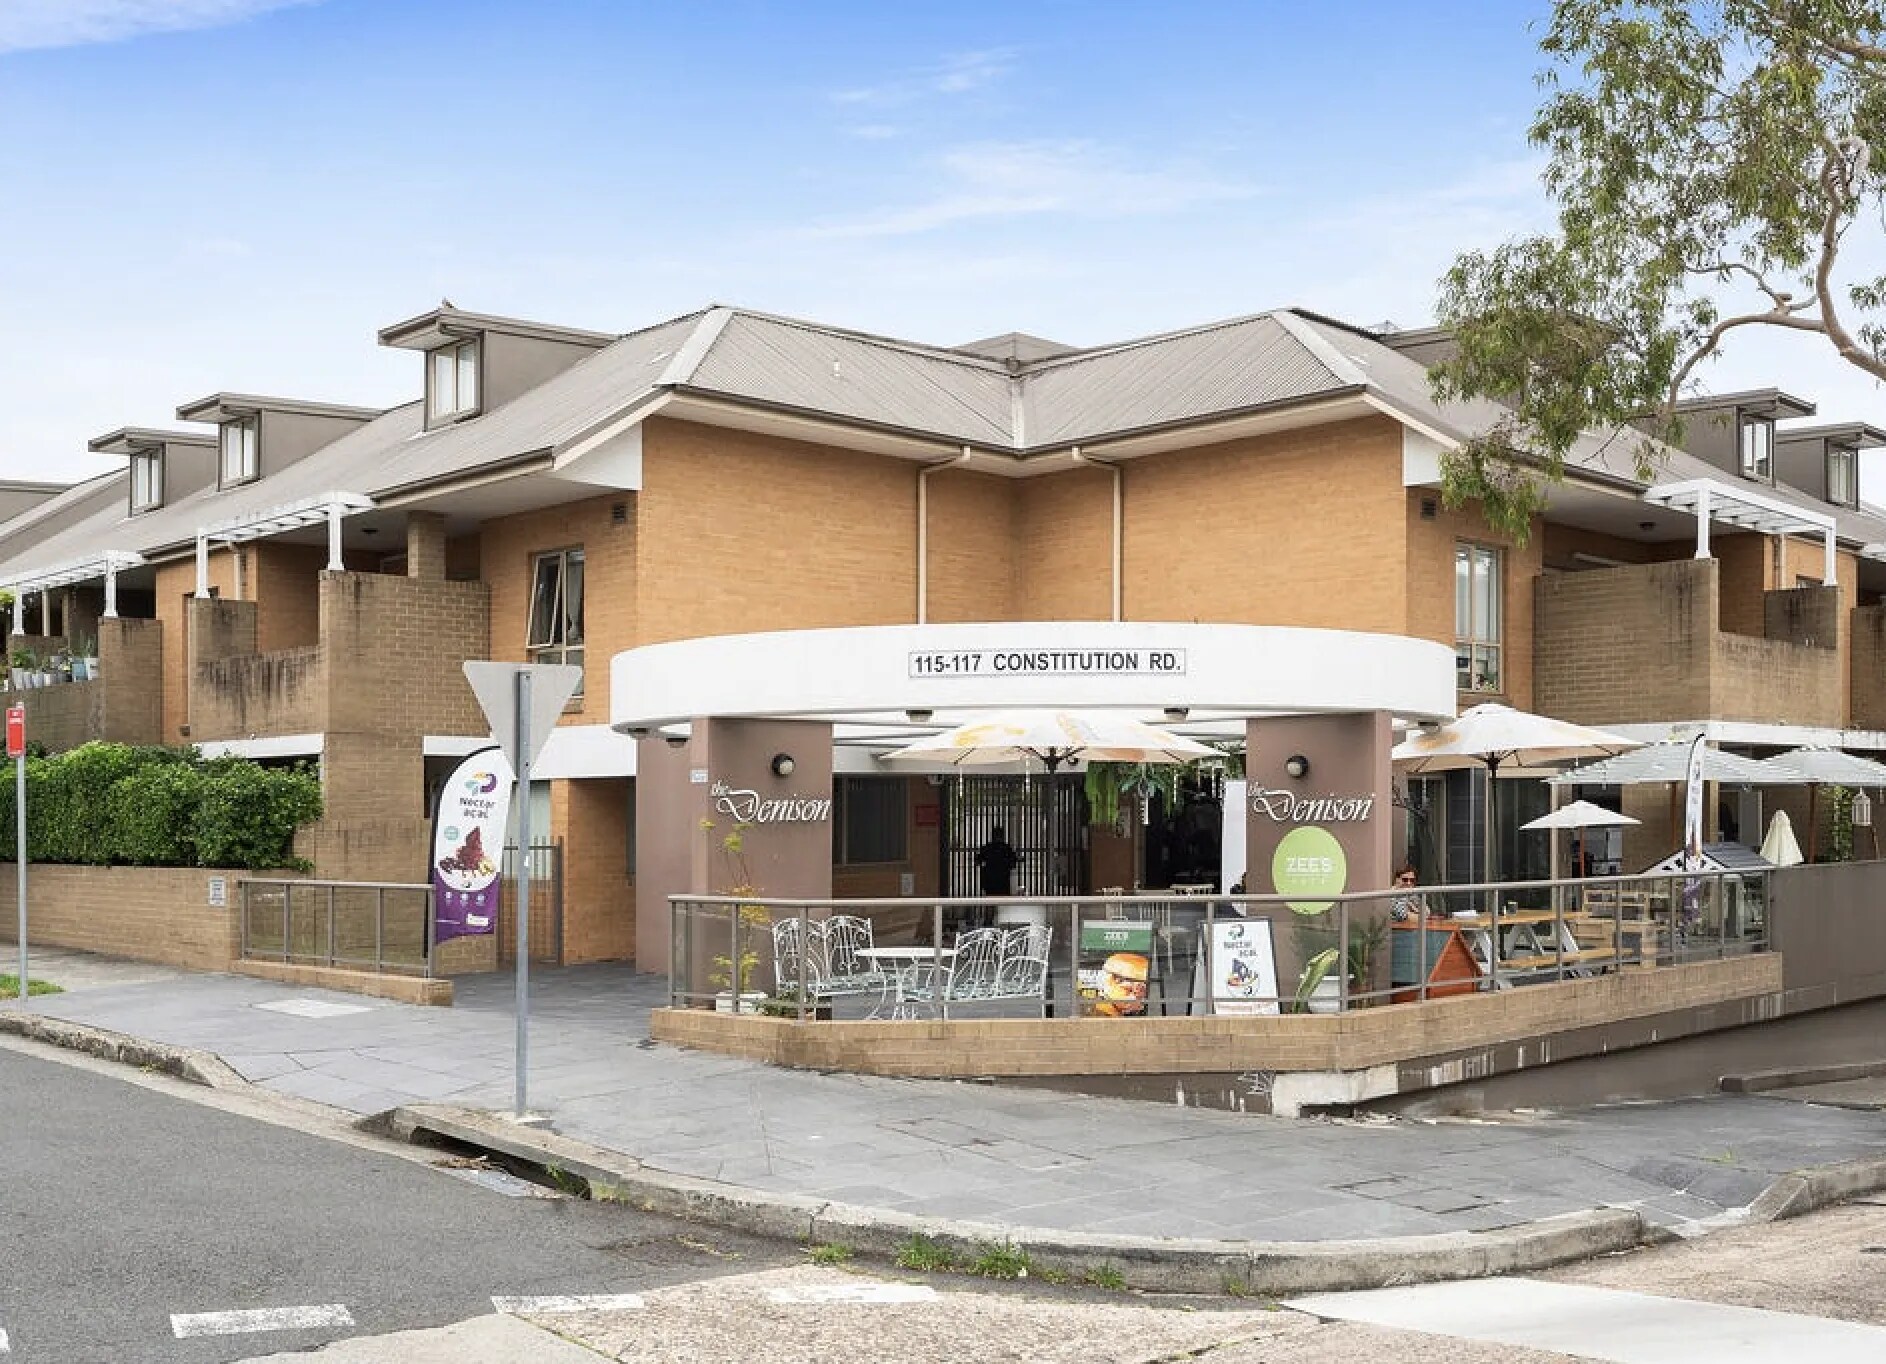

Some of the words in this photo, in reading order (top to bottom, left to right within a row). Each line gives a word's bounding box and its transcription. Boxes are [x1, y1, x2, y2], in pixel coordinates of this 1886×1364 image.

[915, 654, 981, 672] 115-117
[993, 652, 1138, 671] CONSTITUTION
[1149, 653, 1181, 671] RD.
[716, 789, 831, 822] Denison
[1254, 789, 1374, 821] Denison
